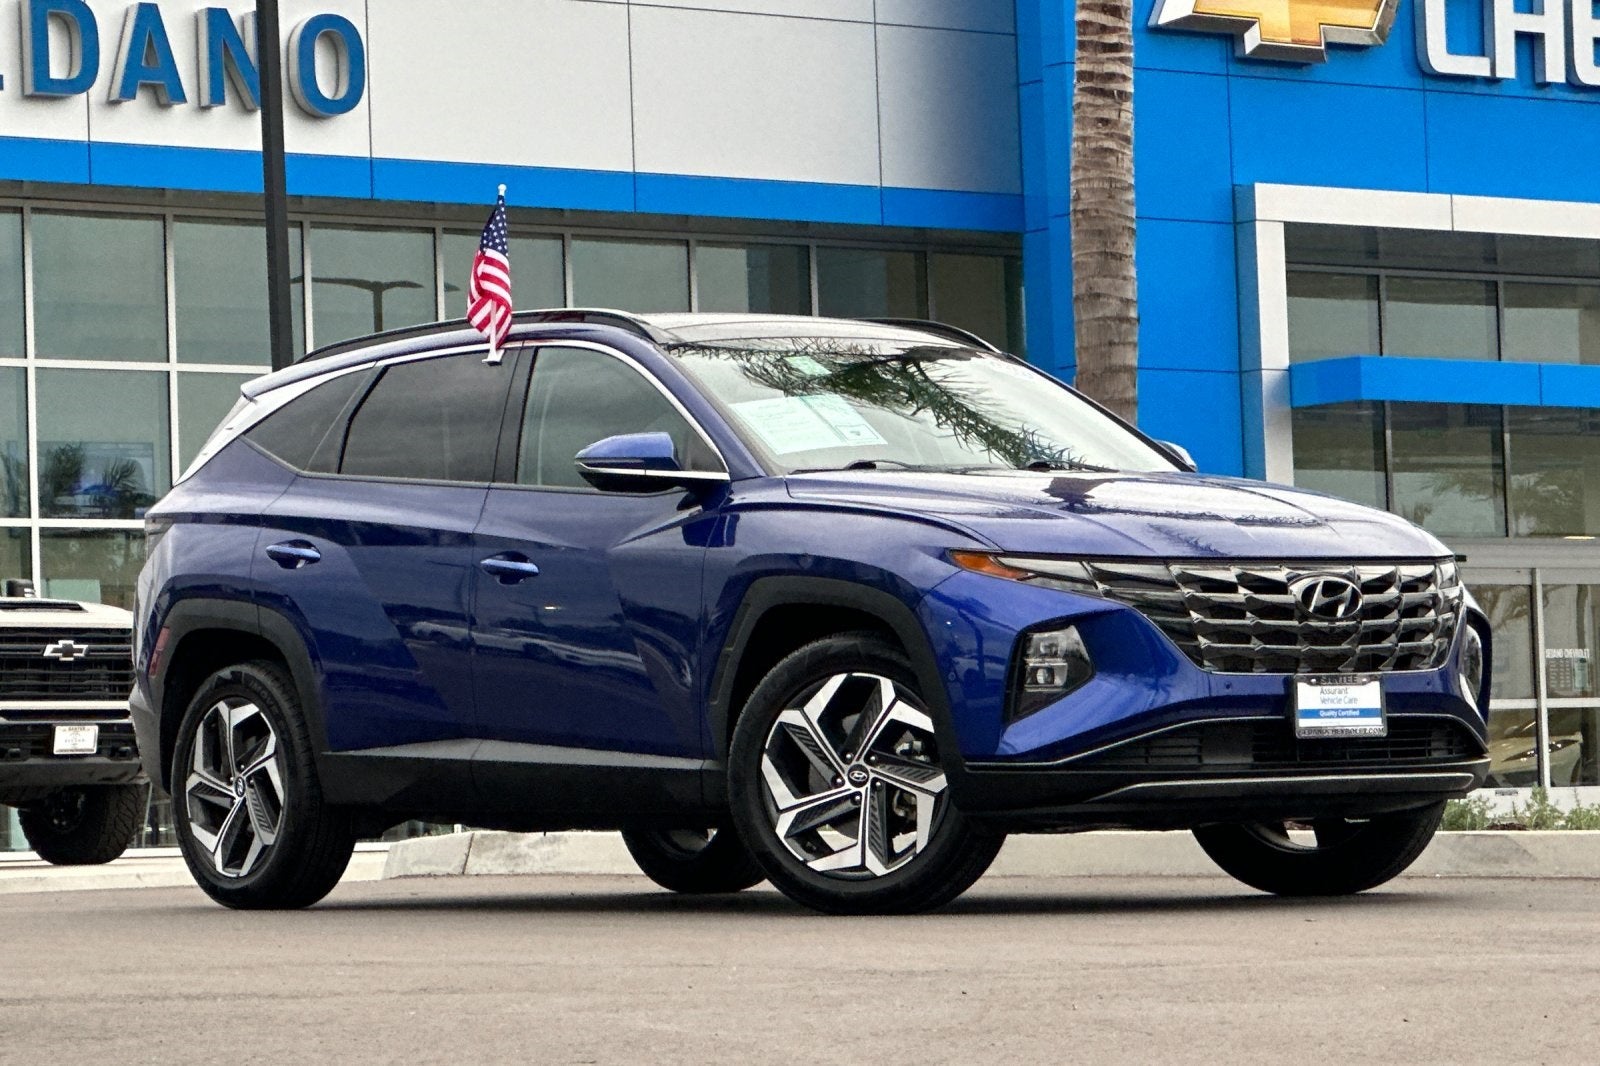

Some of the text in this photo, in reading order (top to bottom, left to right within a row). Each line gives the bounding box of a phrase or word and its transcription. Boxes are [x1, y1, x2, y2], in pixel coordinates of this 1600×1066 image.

[0, 0, 366, 118] DANO
[1320, 687, 1349, 695] Assurant
[1320, 696, 1358, 705] Vehicle Care
[1319, 710, 1337, 718] Quality
